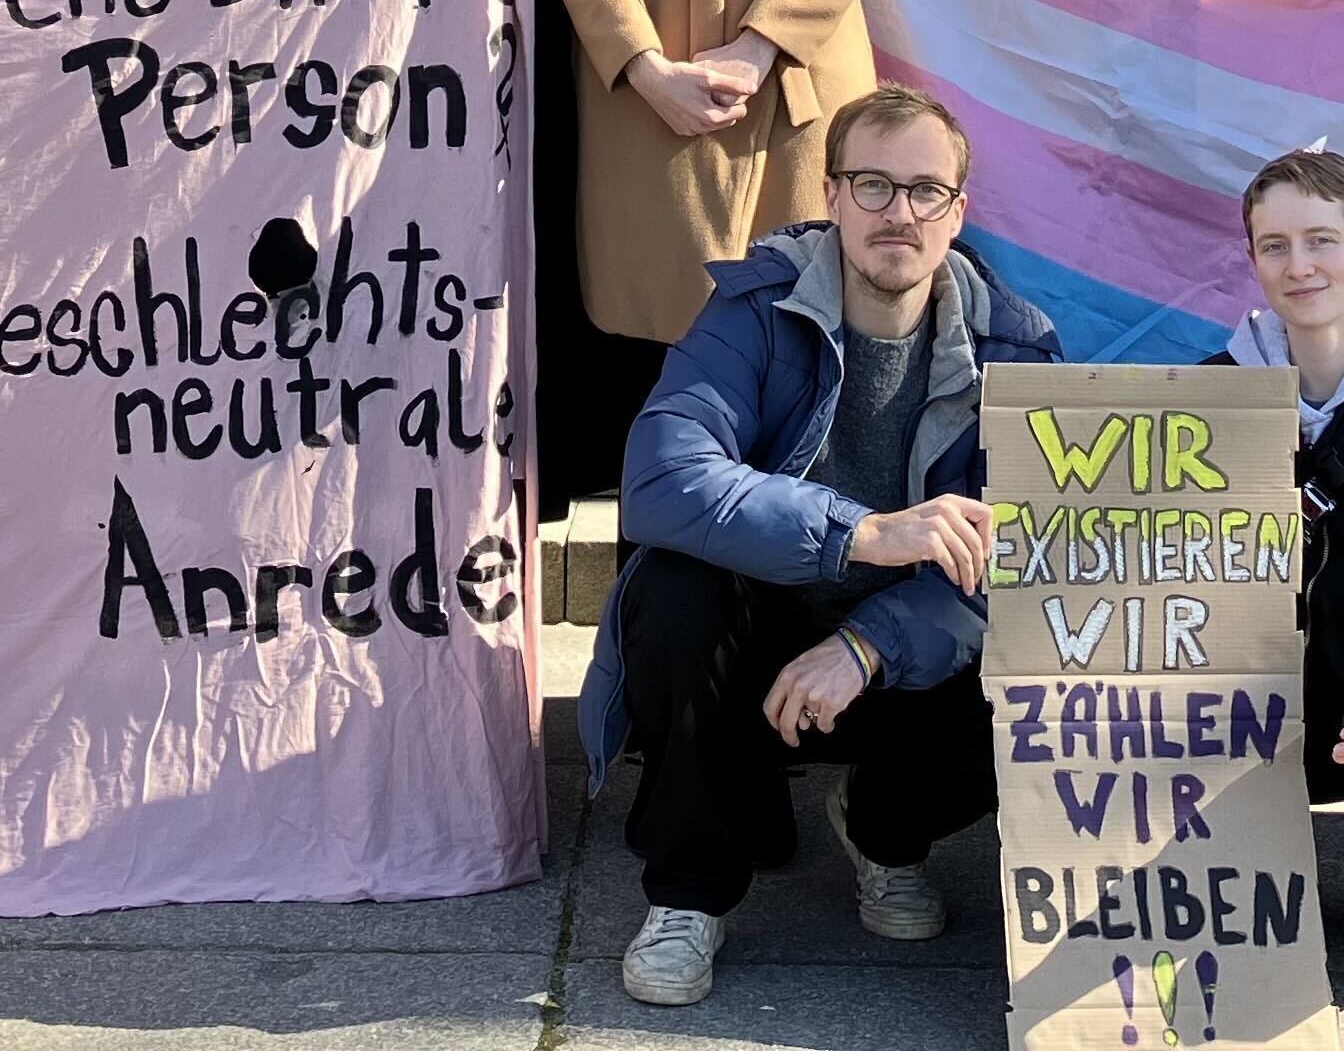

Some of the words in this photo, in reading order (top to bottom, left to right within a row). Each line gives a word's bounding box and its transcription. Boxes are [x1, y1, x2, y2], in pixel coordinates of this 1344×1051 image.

[114, 350, 514, 460] neutrale
[1024, 406, 1229, 494] WIR
[99, 476, 518, 643] Anrede
[987, 501, 1300, 589] EXISTIEREN
[1043, 595, 1212, 672] WIR
[1004, 679, 1287, 764] ZÄHLEN
[1053, 771, 1213, 844] WIR
[1012, 866, 1306, 948] BLEIBEN
